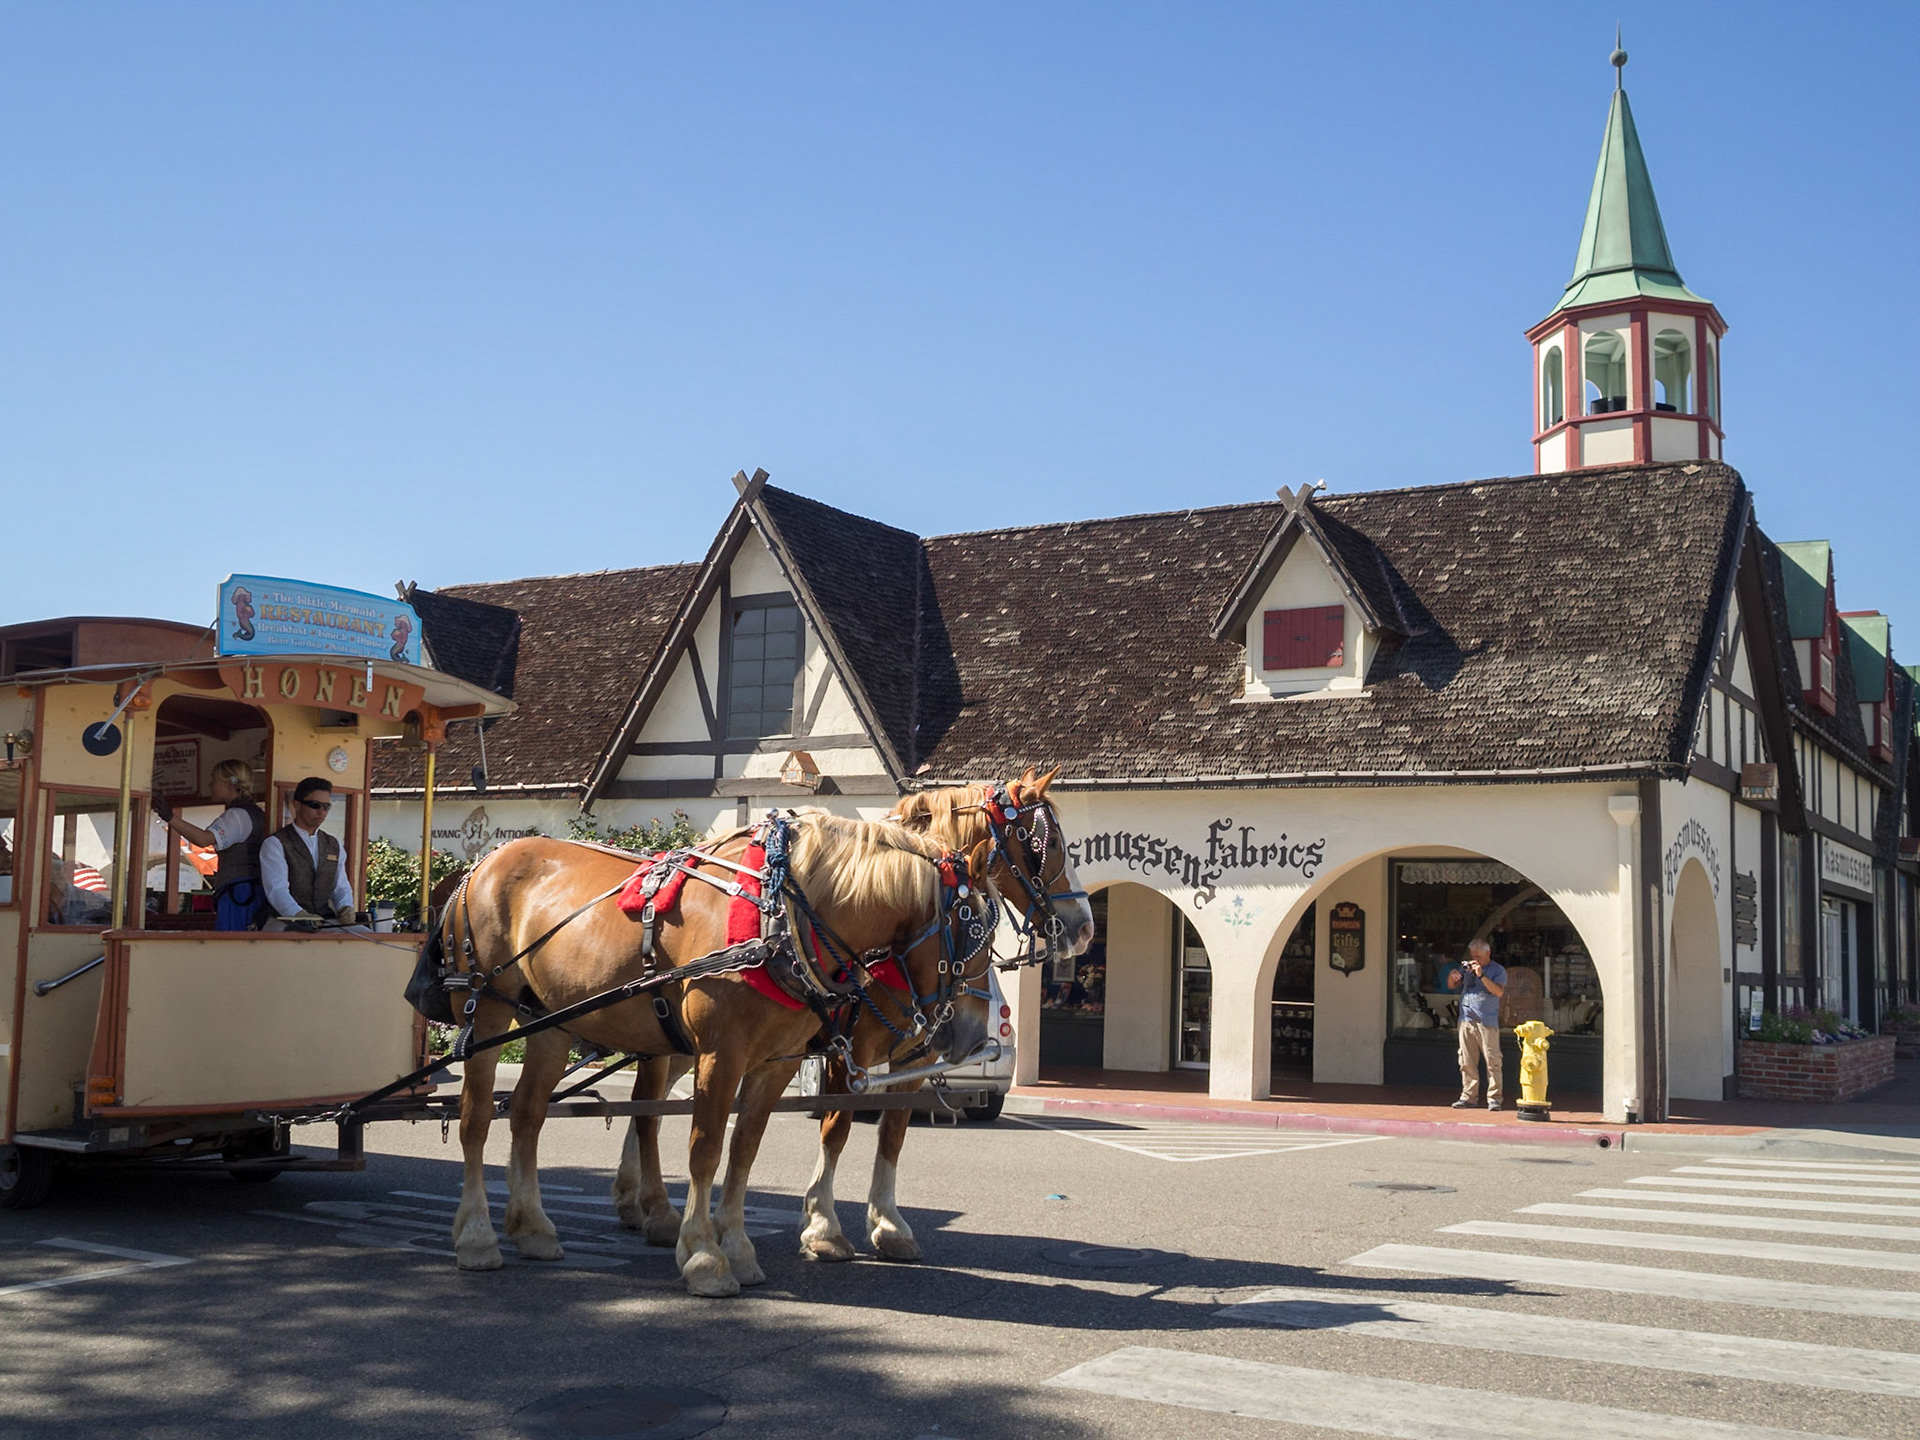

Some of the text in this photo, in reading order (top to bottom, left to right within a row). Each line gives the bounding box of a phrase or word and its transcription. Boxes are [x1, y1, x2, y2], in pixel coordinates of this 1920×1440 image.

[272, 591, 294, 604] The
[329, 600, 377, 618] Mermaid
[257, 622, 308, 636] Breakfast
[259, 604, 387, 638] RESTAURANT
[420, 829, 461, 839] LVANG
[1333, 933, 1360, 952] Gifts
